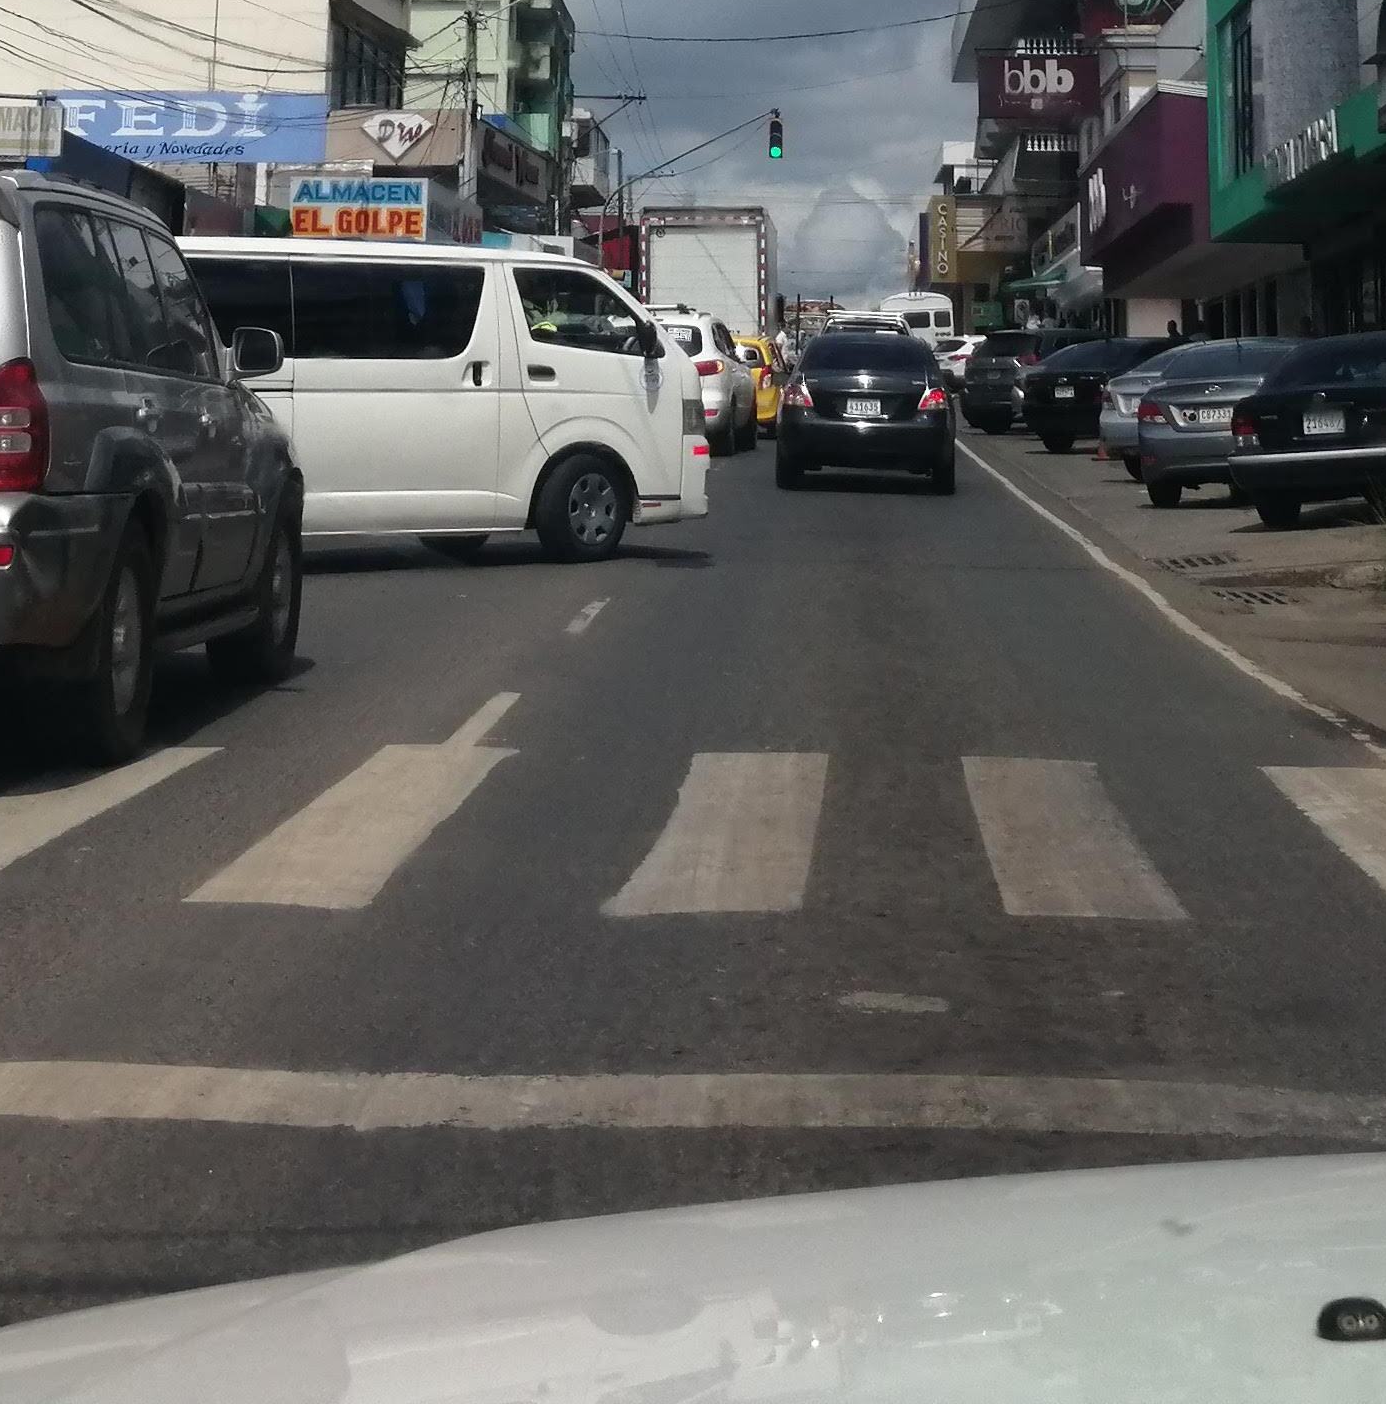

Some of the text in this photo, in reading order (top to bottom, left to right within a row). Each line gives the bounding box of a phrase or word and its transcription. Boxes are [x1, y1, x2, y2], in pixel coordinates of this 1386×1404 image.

[1004, 59, 1075, 94] bbb
[159, 140, 246, 156] Novedades
[293, 179, 423, 204] ALMACEN
[293, 209, 333, 235] EL
[336, 208, 424, 237] GOLPE
[936, 203, 949, 274] CASINO
